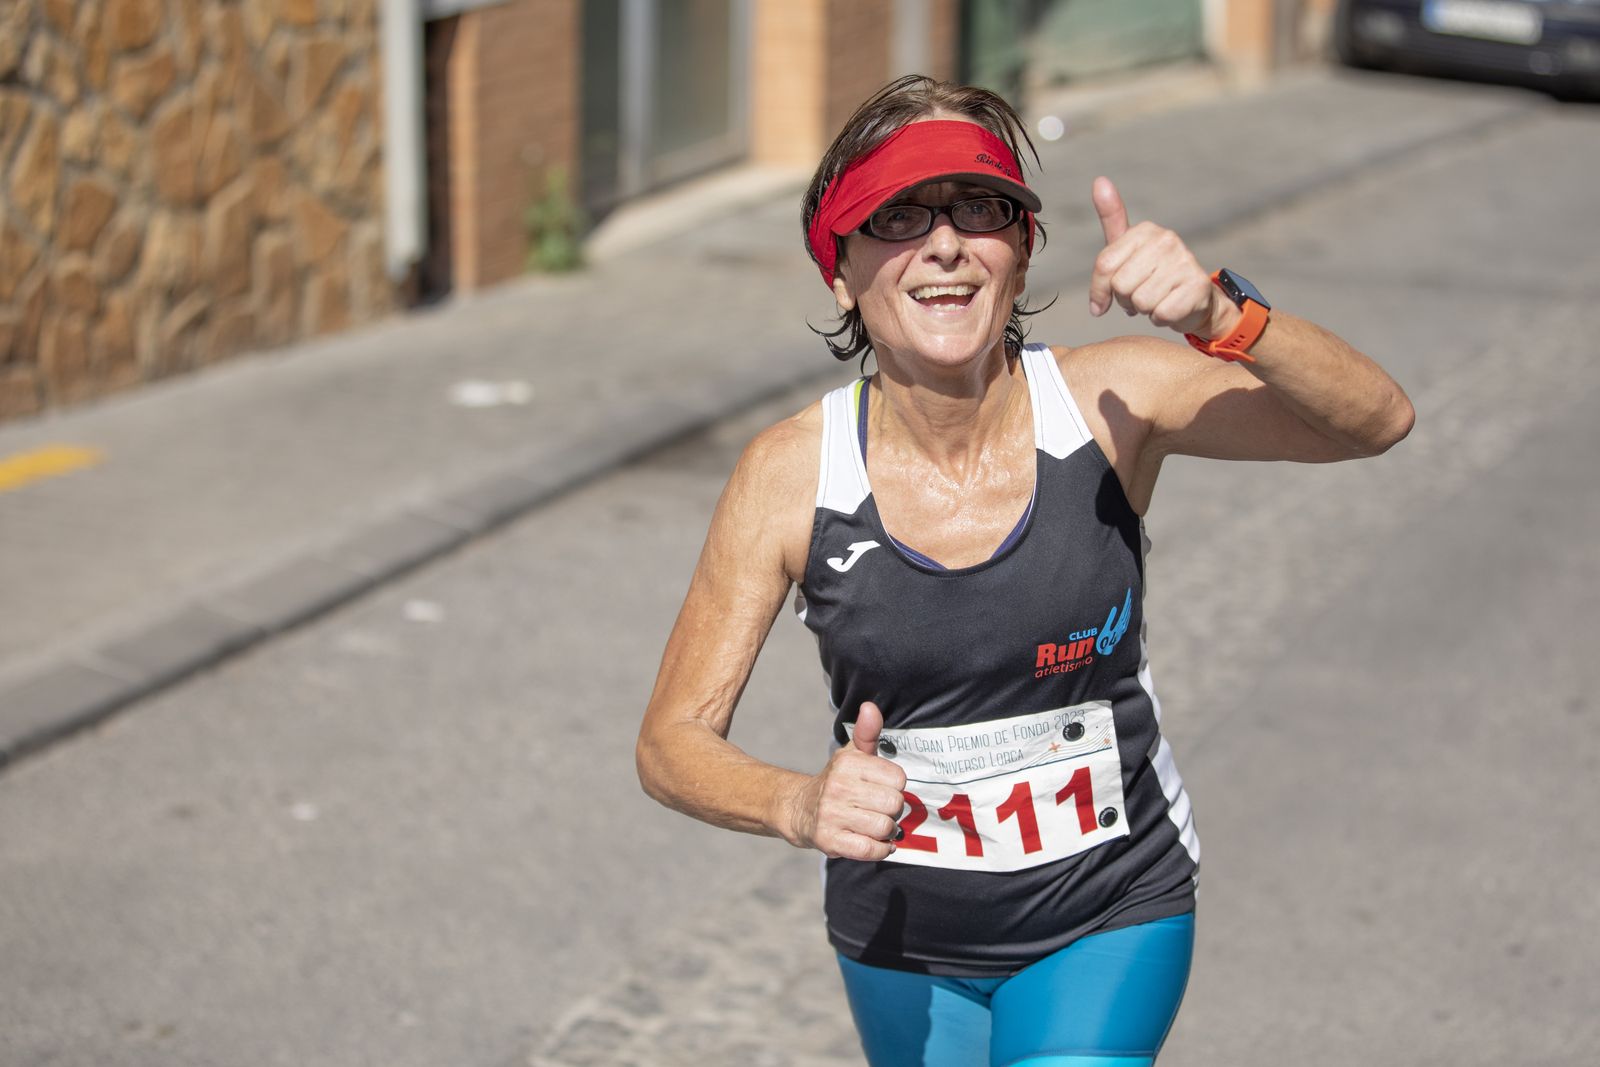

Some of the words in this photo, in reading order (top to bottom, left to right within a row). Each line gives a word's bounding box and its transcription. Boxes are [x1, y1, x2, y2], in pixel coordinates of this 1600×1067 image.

[1069, 627, 1098, 641] CLUB
[1036, 637, 1095, 668] Run
[1035, 656, 1093, 679] atletismo
[914, 736, 944, 753] GRAN
[947, 733, 990, 753] PREMIO
[994, 729, 1009, 746] DE
[1012, 721, 1050, 741] FONDO
[932, 755, 986, 775] UNIVERSO
[989, 749, 1024, 767] LORCA
[892, 766, 1098, 858] 2111
